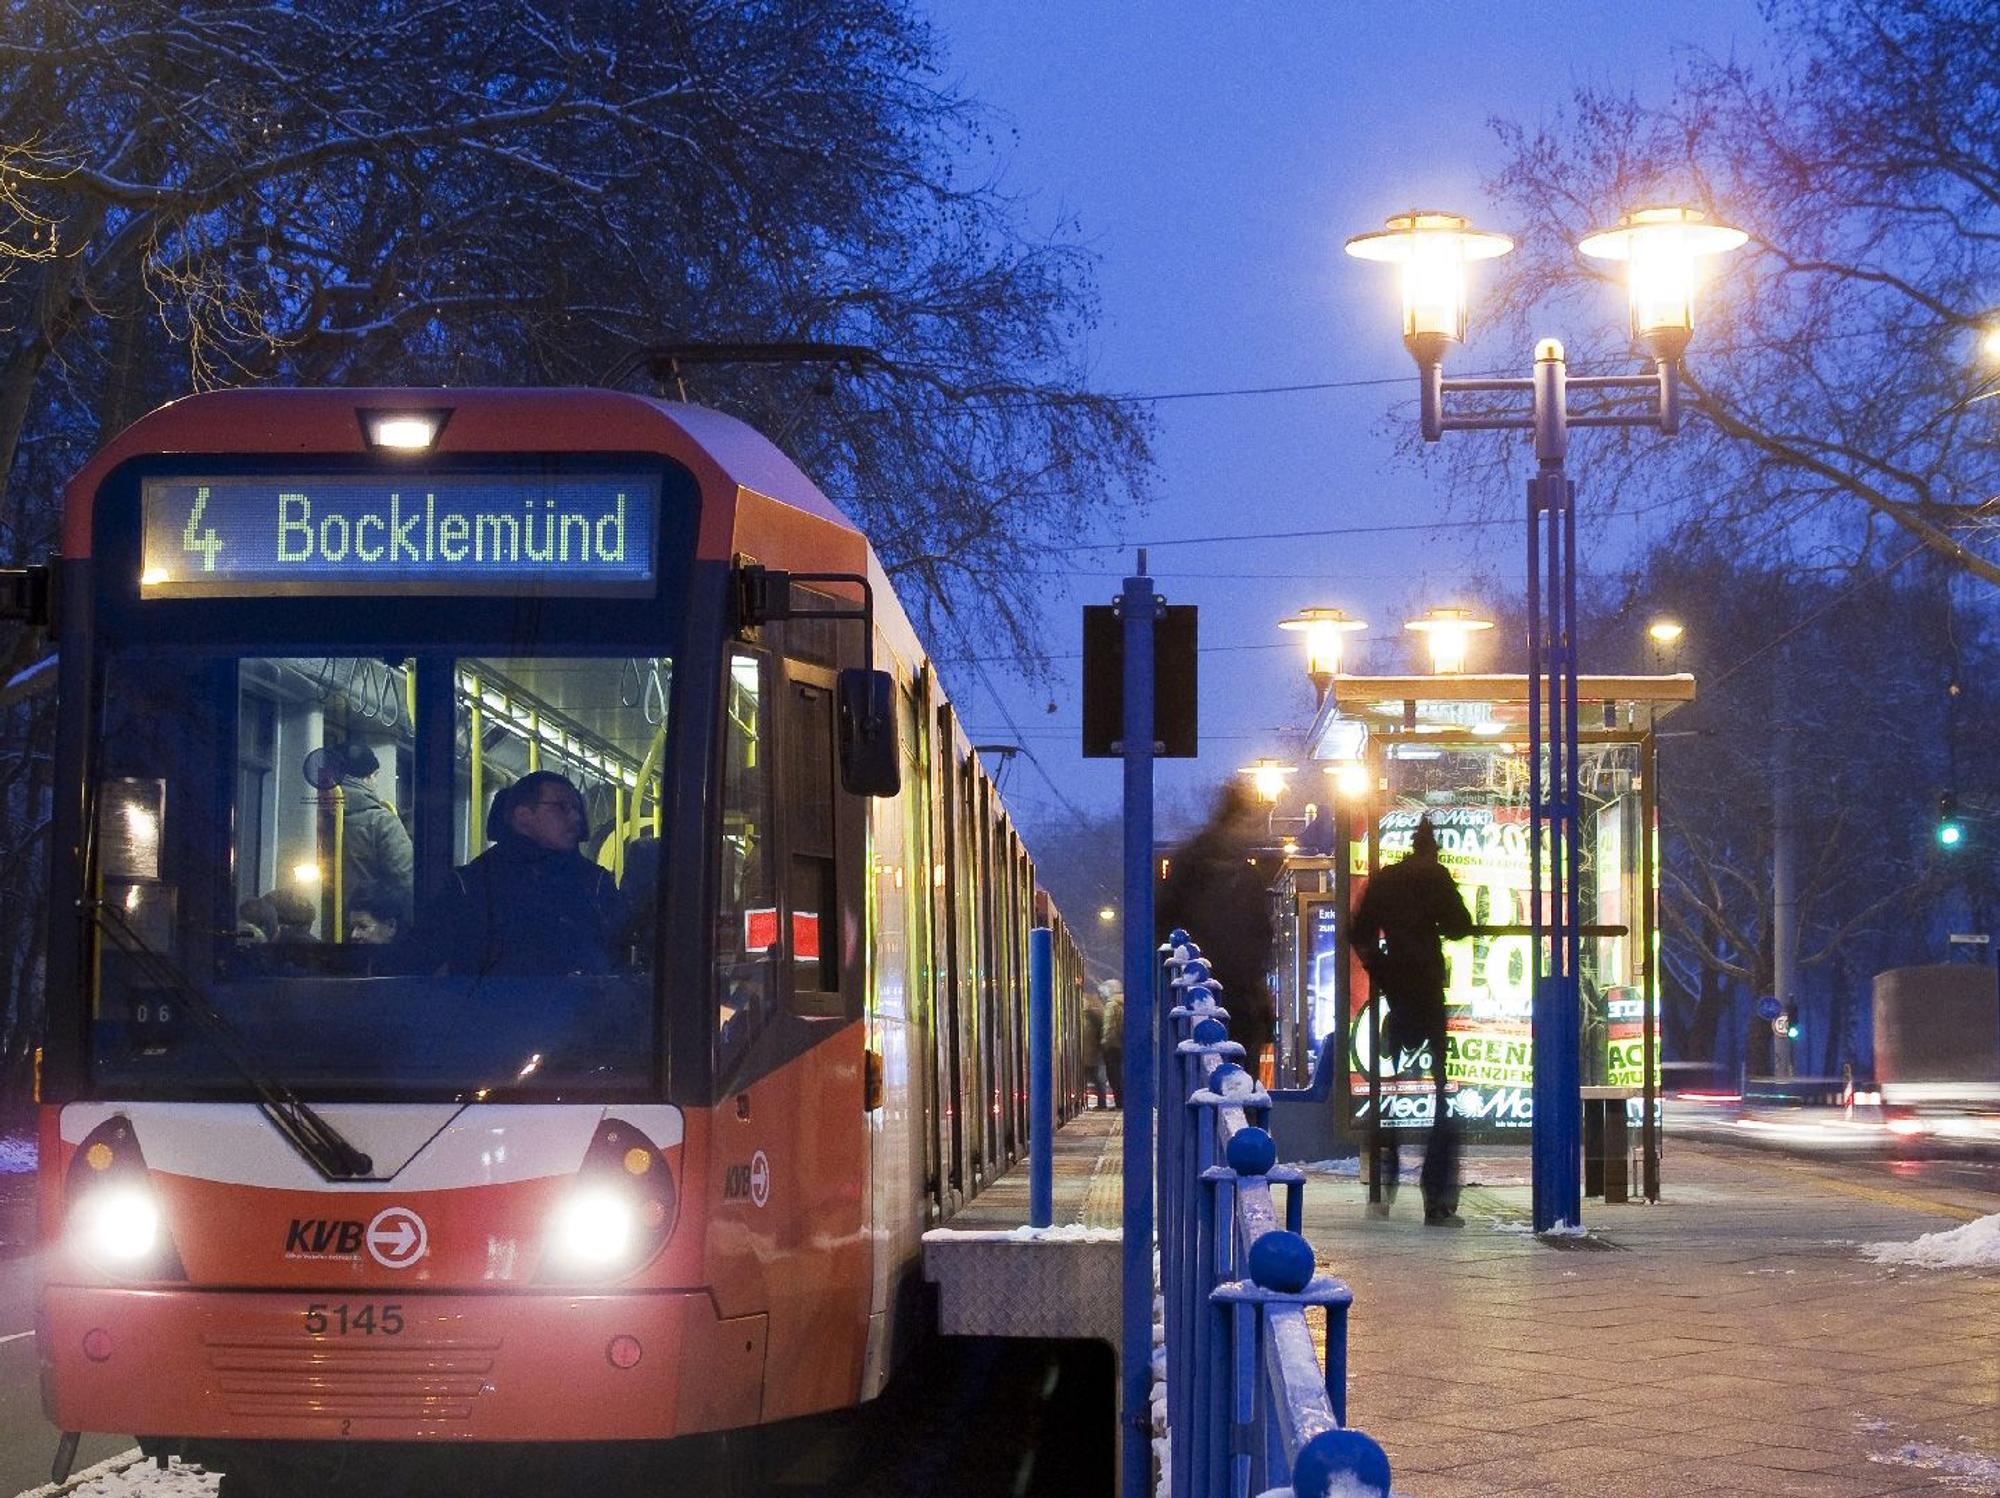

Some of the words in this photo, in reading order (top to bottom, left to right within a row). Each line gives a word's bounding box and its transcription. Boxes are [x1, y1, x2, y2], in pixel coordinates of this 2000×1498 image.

[183, 488, 222, 571] 4
[277, 494, 625, 561] Bocklemünd
[1379, 809, 1427, 829] Med
[1319, 909, 1335, 919] Exk
[1446, 1036, 1532, 1066] AGEN
[1445, 1062, 1533, 1081] INANZIER
[1355, 1091, 1454, 1117] Med
[1479, 1089, 1532, 1117] Ma
[286, 1220, 364, 1253] KVB
[305, 1304, 404, 1335] 5145
